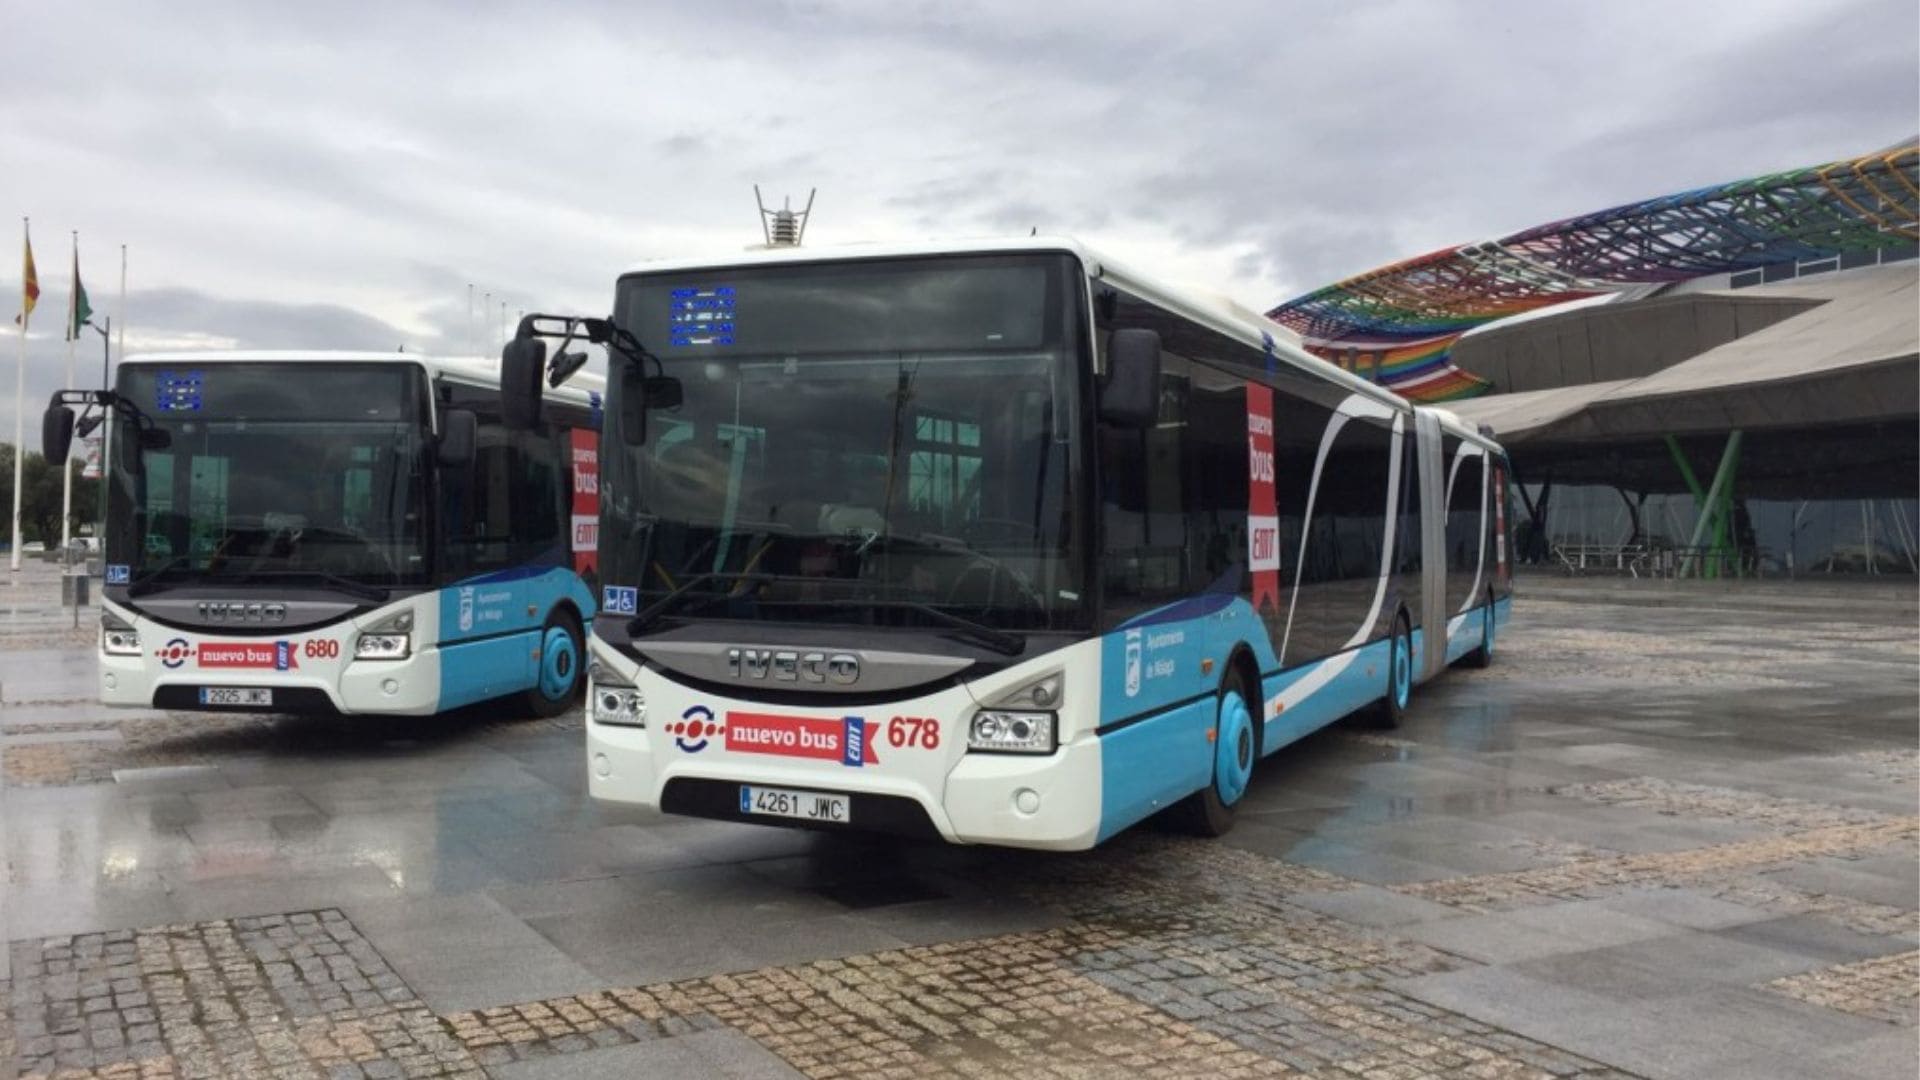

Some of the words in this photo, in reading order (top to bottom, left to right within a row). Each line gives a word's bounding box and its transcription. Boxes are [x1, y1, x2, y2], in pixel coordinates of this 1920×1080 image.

[1250, 435, 1274, 483] bus
[573, 464, 598, 494] bus
[1253, 527, 1275, 560] EMT
[199, 602, 286, 622] IVECO
[202, 650, 245, 662] nuevo
[247, 649, 273, 662] bus
[304, 639, 339, 659] 680
[728, 648, 860, 685] IVECO
[210, 689, 240, 702] 2925
[732, 725, 796, 747] nuevo
[799, 726, 838, 750] bus
[847, 722, 862, 761] EMT
[887, 716, 940, 749] 678
[756, 792, 798, 813] 4261
[808, 798, 843, 820] JWC
